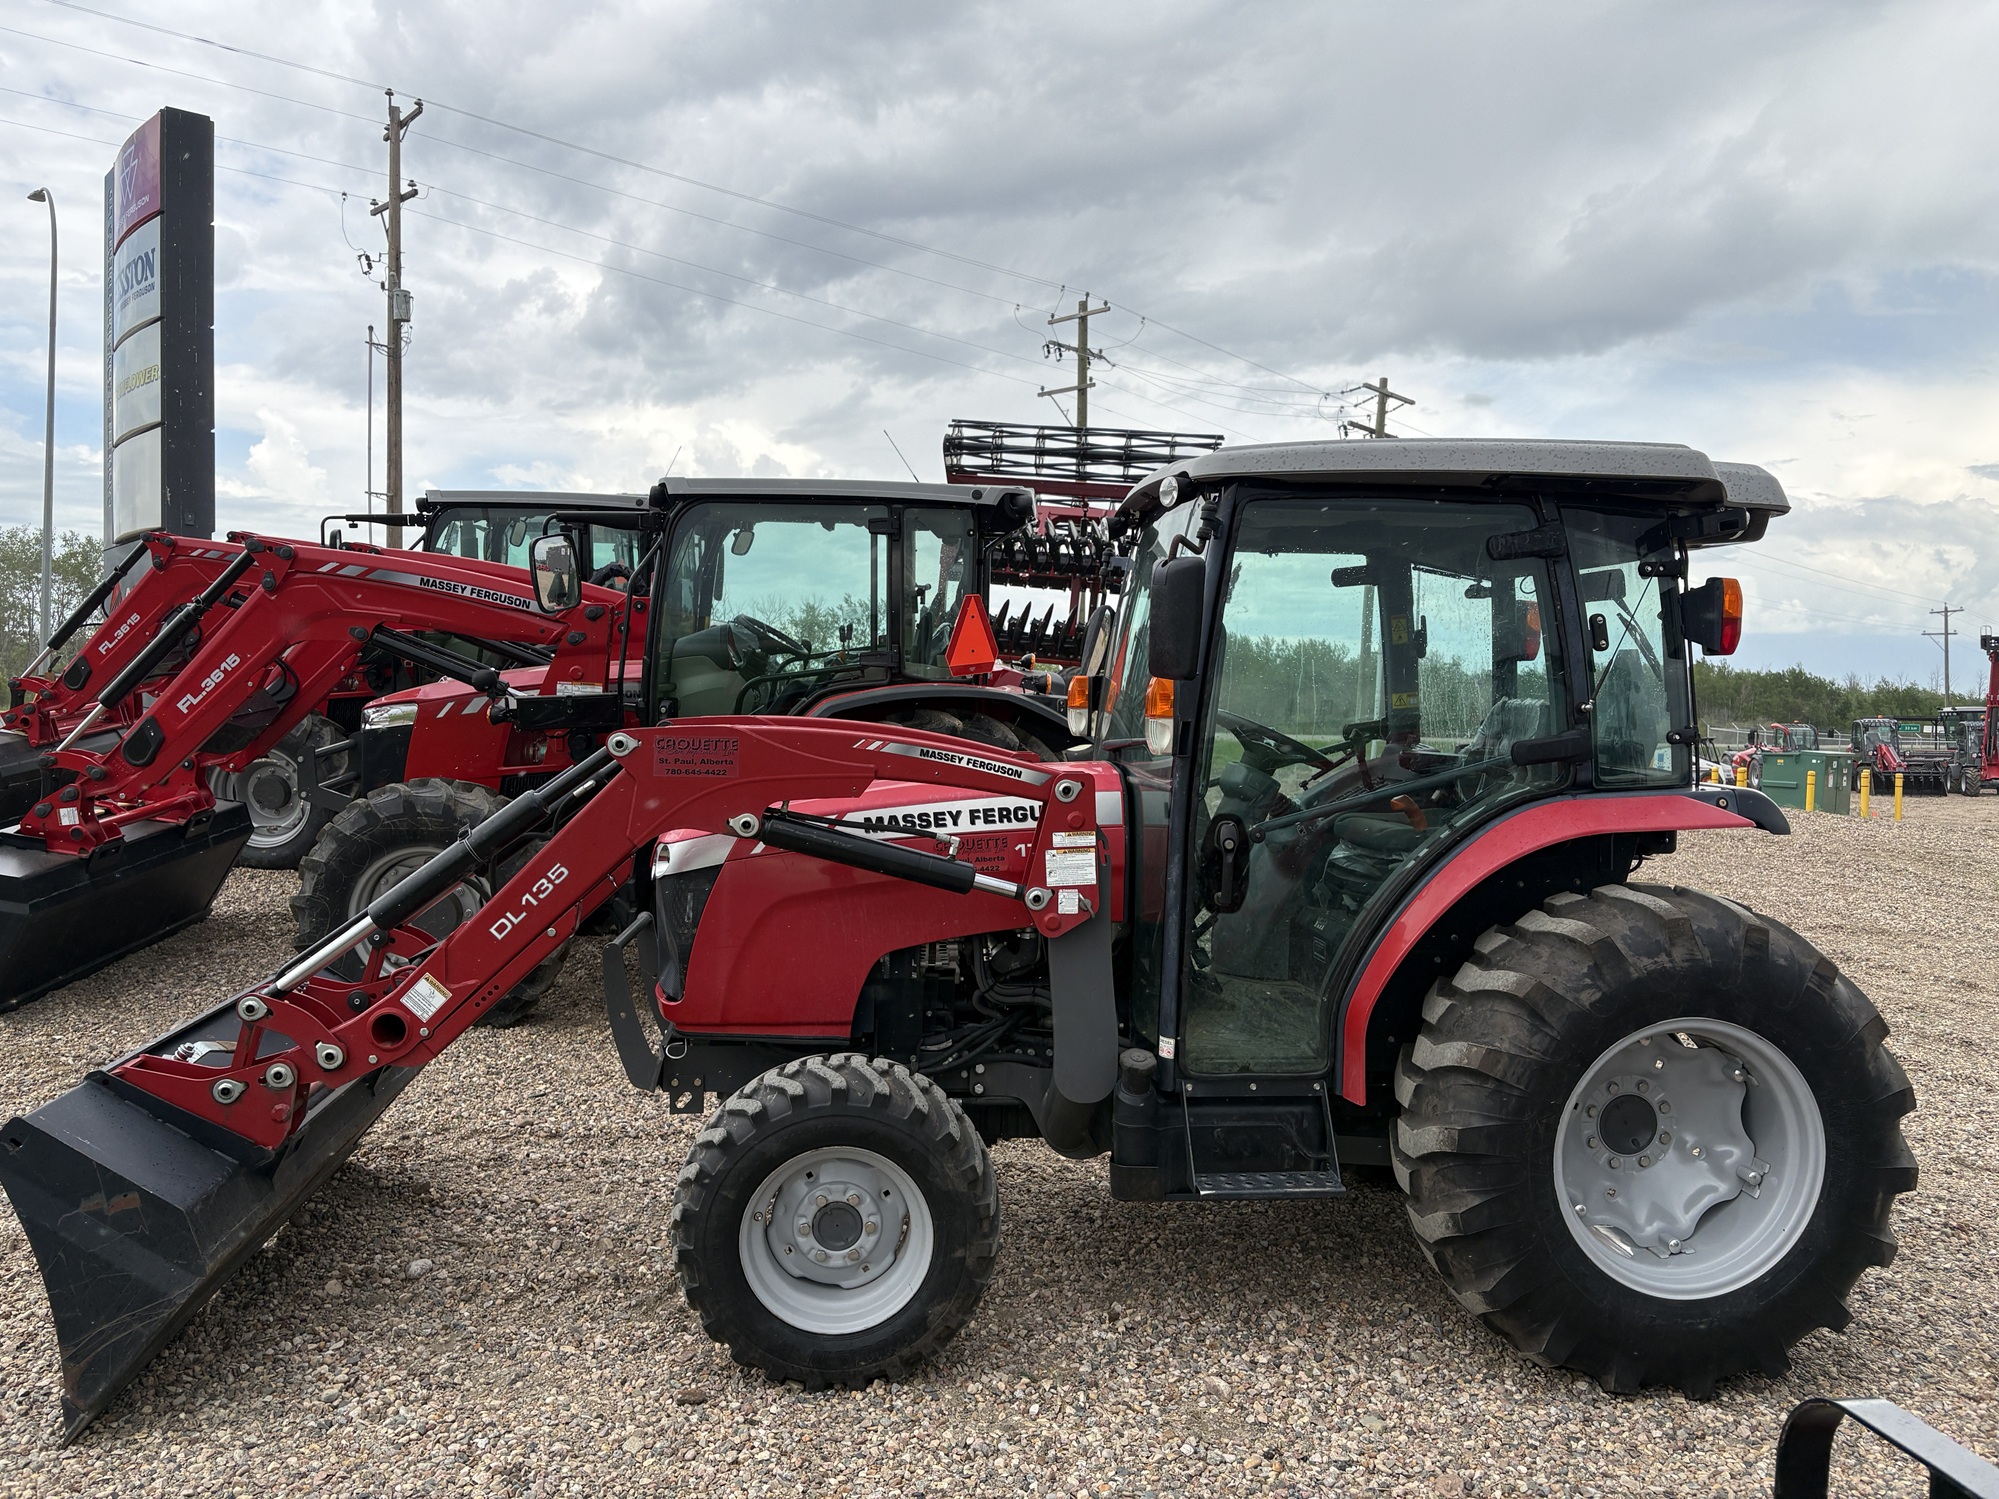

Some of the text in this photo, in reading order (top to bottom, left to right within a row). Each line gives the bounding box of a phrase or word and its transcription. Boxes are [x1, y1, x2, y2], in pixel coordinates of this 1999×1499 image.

[126, 194, 150, 219] FERGUSON
[116, 247, 156, 298] SSTON
[132, 281, 156, 303] FERGUSON
[119, 364, 160, 399] NFLOWER
[419, 576, 531, 610] MASSEY FERGUSON
[176, 652, 241, 715] FL.3615
[658, 757, 671, 765] St.
[674, 757, 697, 766] Paul,
[665, 768, 727, 776] 780-645-4422
[919, 748, 1023, 779] MASSEY FERGUSON
[863, 804, 1042, 833] MASSEY FERGU
[974, 855, 1005, 863] Alberta
[428, 978, 450, 999] WARNING
